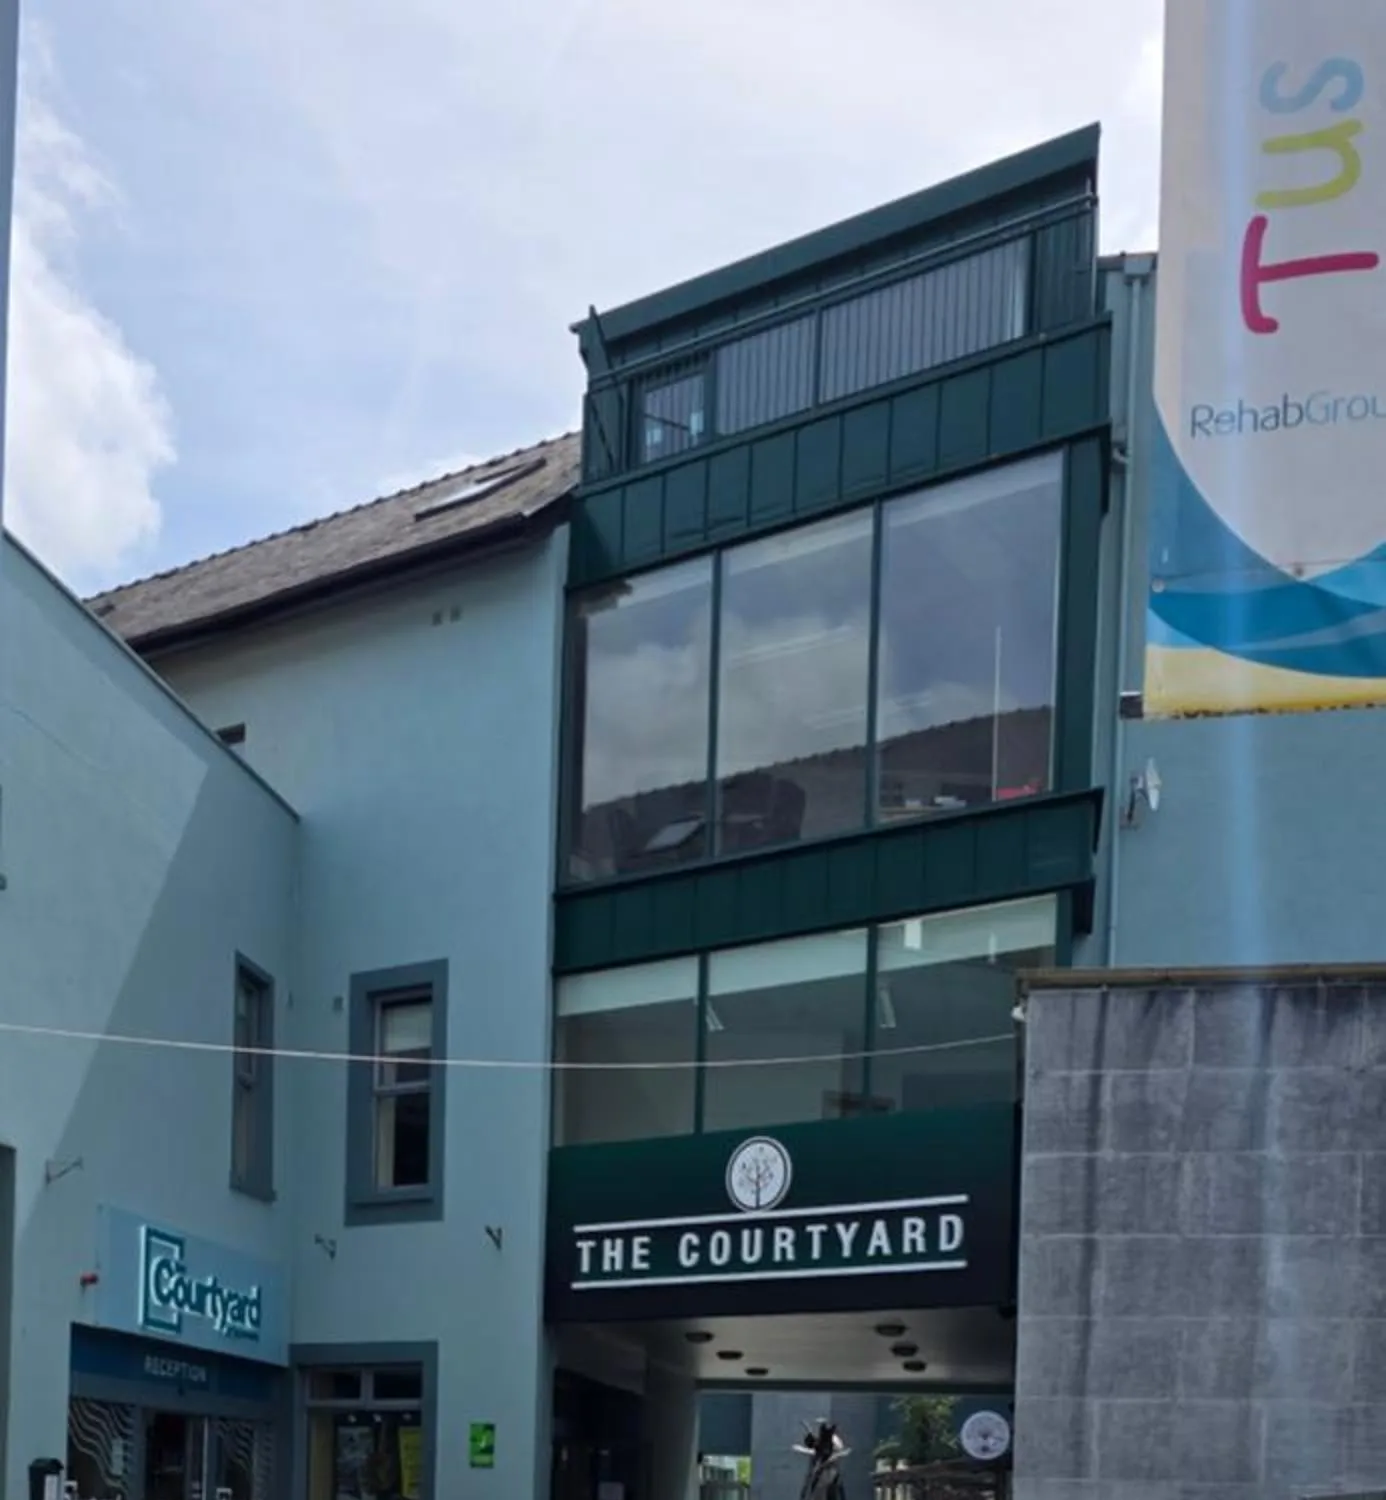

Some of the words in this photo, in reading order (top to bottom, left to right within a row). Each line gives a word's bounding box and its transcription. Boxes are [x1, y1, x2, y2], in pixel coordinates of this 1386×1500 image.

[1240, 57, 1379, 334] Tus
[576, 1236, 651, 1273] THE
[678, 1214, 964, 1268] COURTYARD
[149, 1255, 261, 1331] Courtyard
[144, 1355, 207, 1383] RECEPTION
